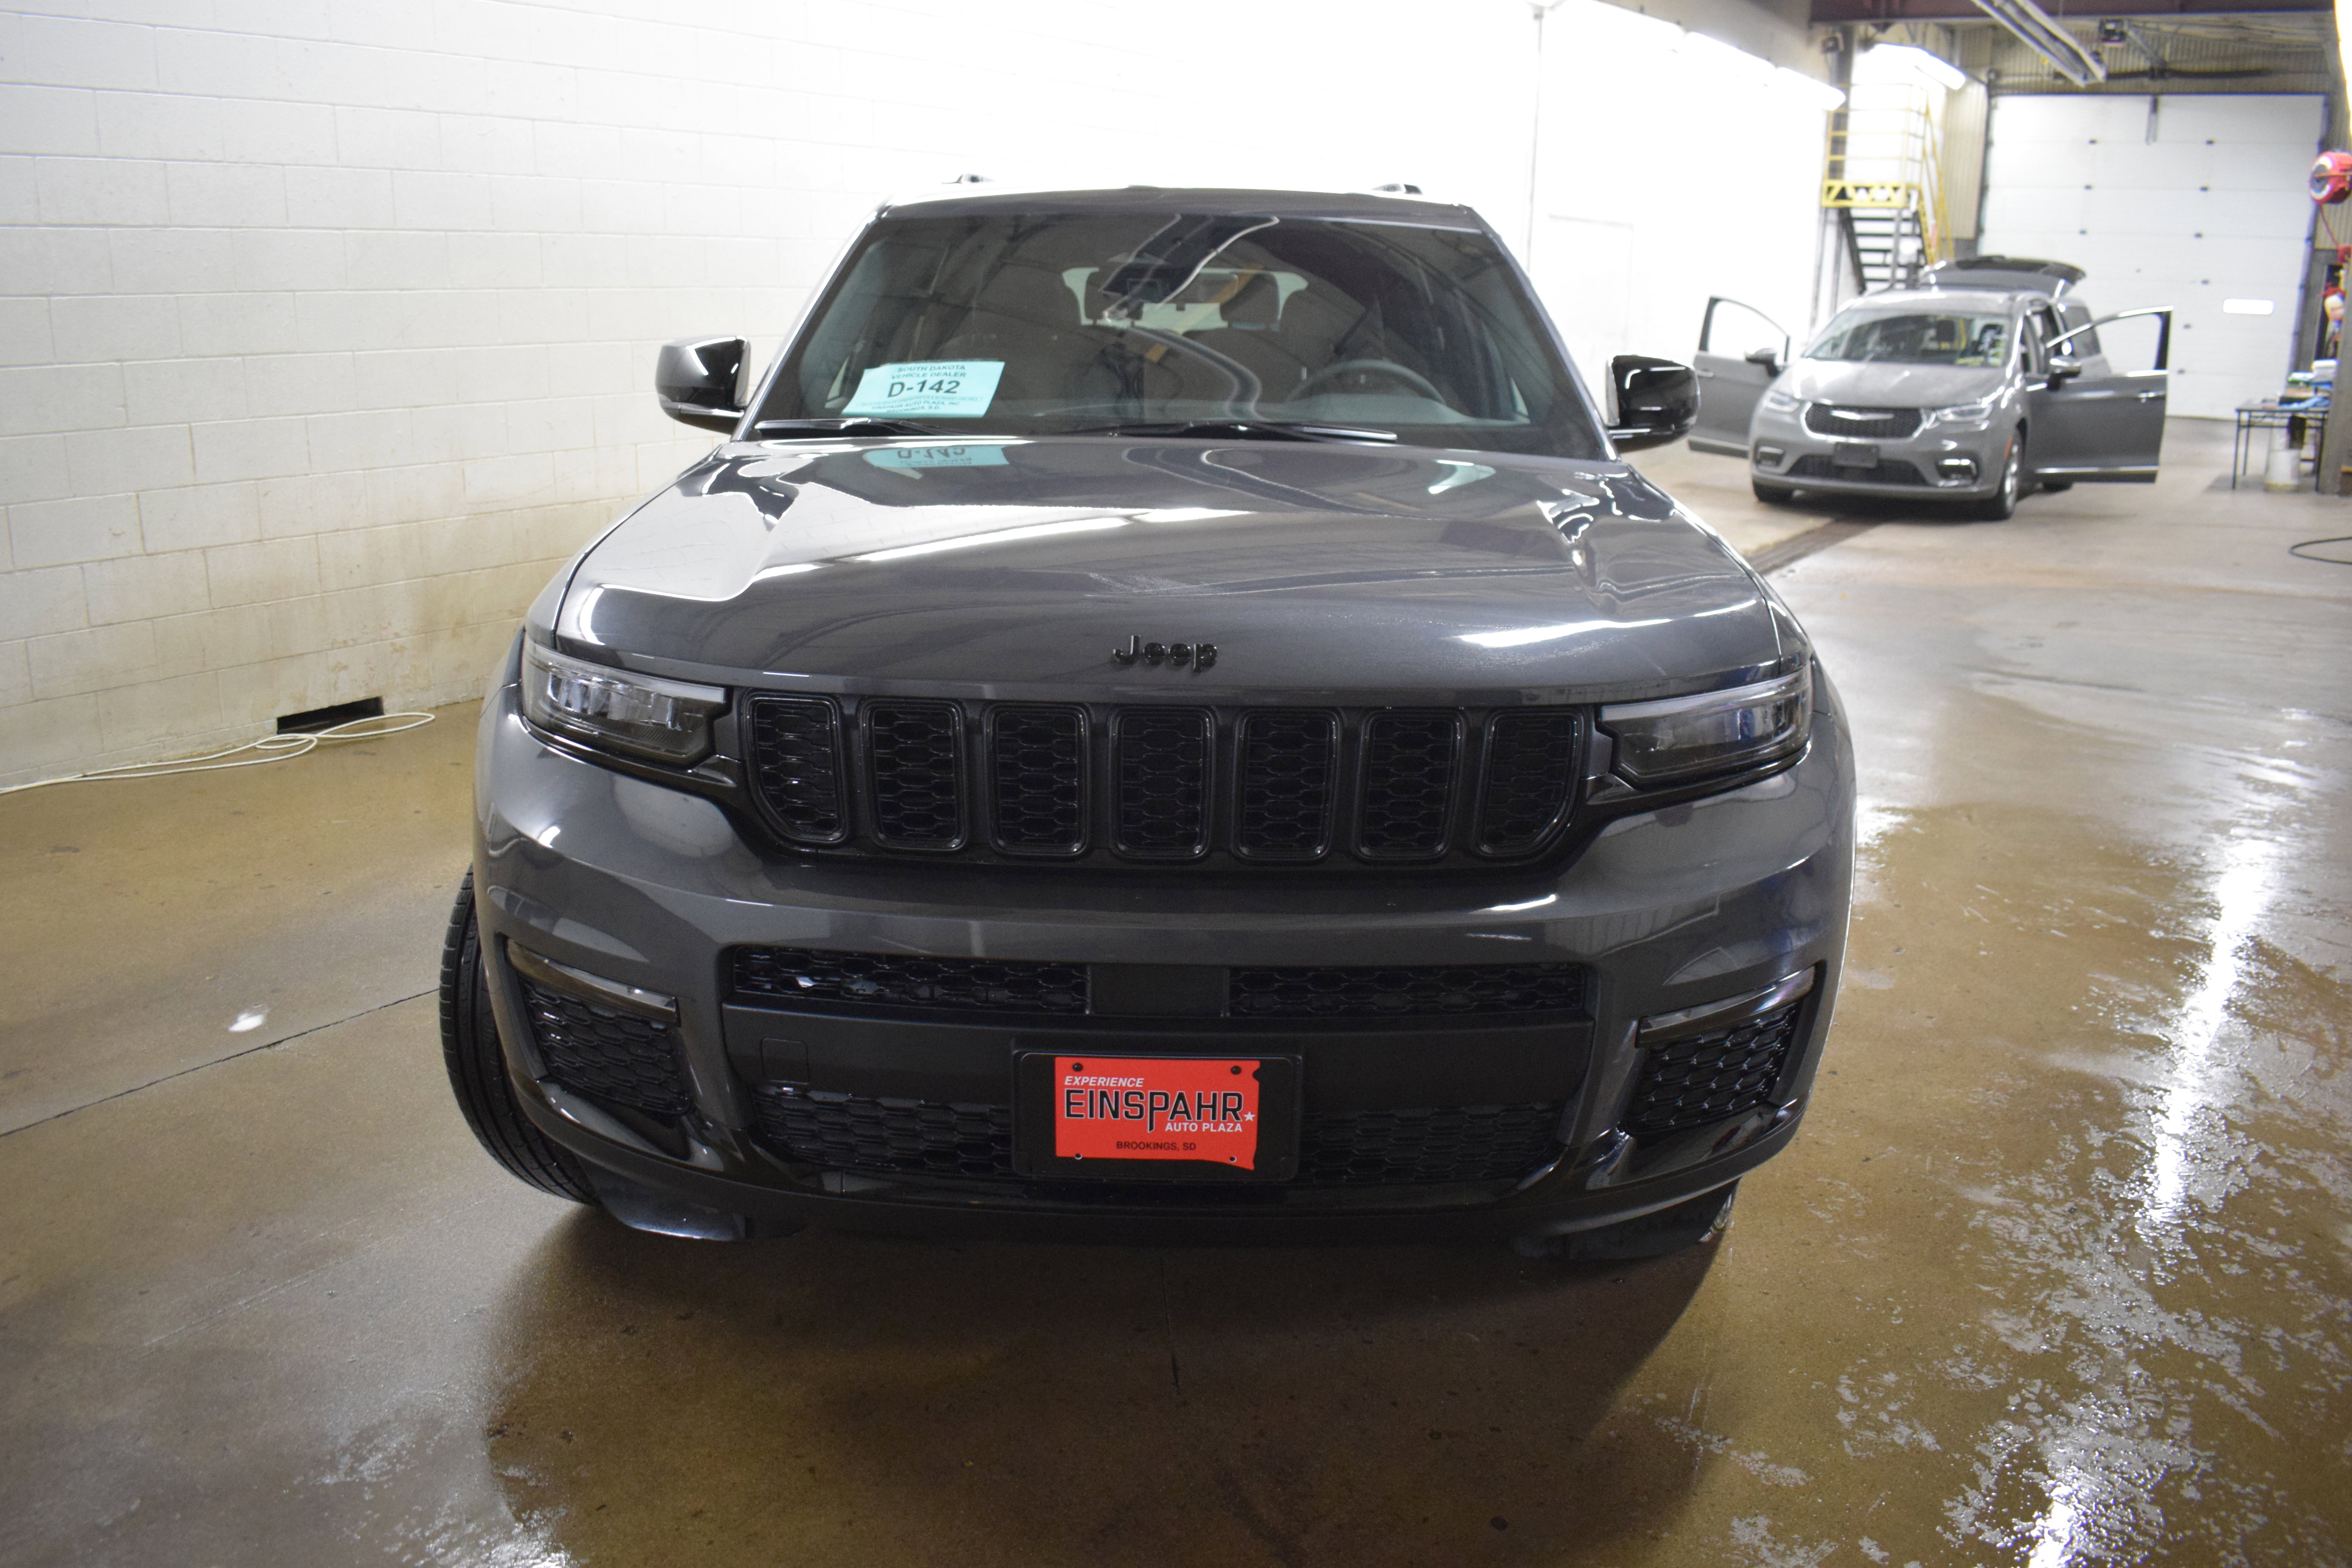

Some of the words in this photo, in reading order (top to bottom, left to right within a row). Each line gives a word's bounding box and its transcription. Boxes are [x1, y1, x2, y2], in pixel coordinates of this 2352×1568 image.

[887, 379, 961, 398] D-142
[1113, 635, 1218, 673] Jeep
[1064, 1076, 1145, 1088] EXPERIENCE
[1064, 1088, 1243, 1134] EINSPAHR
[1165, 1122, 1198, 1132] AUTO
[1202, 1123, 1243, 1132] PLAZA
[1116, 1141, 1180, 1152] BROOKINGS,
[1182, 1142, 1196, 1151] SD
